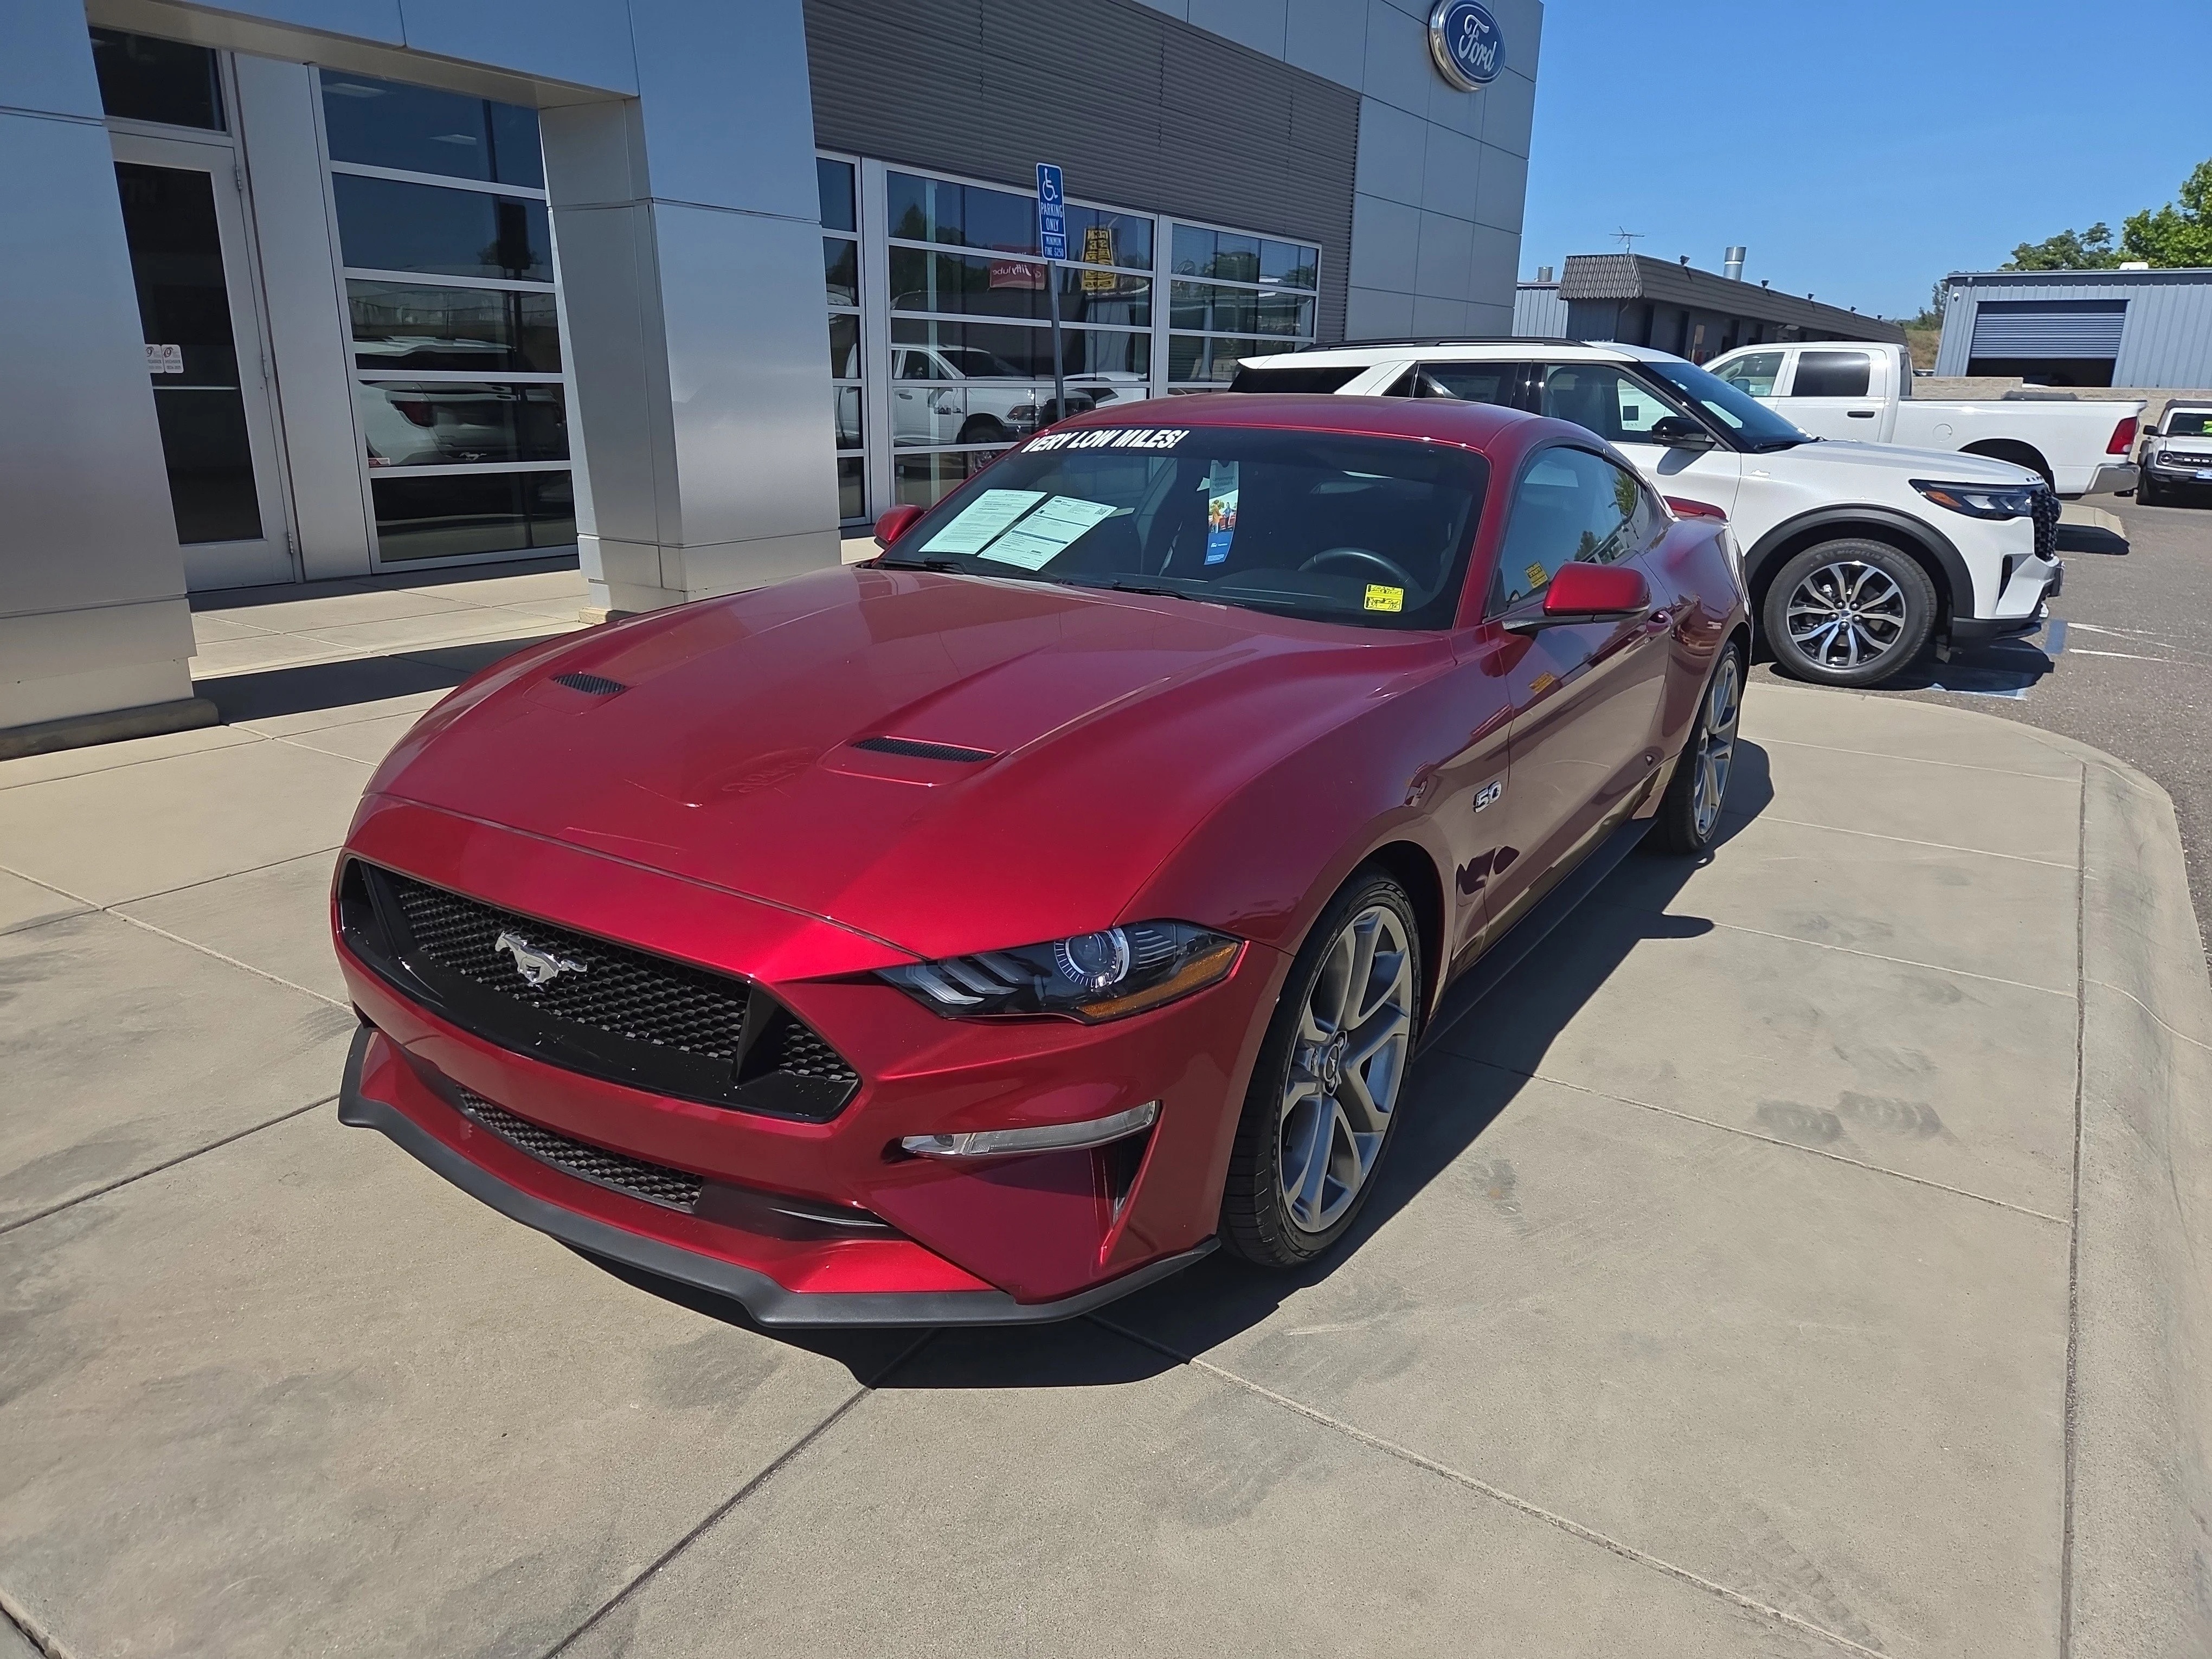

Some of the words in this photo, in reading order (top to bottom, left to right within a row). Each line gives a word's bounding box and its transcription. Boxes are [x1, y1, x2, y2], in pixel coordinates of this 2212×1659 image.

[1458, 15, 1497, 72] Ford
[1040, 202, 1063, 218] PARKING
[1046, 217, 1059, 232] ONLY
[1054, 247, 1064, 257] $250
[1020, 431, 1079, 453] VERY
[1066, 429, 1122, 449] LOW
[1110, 429, 1190, 449] MILES!
